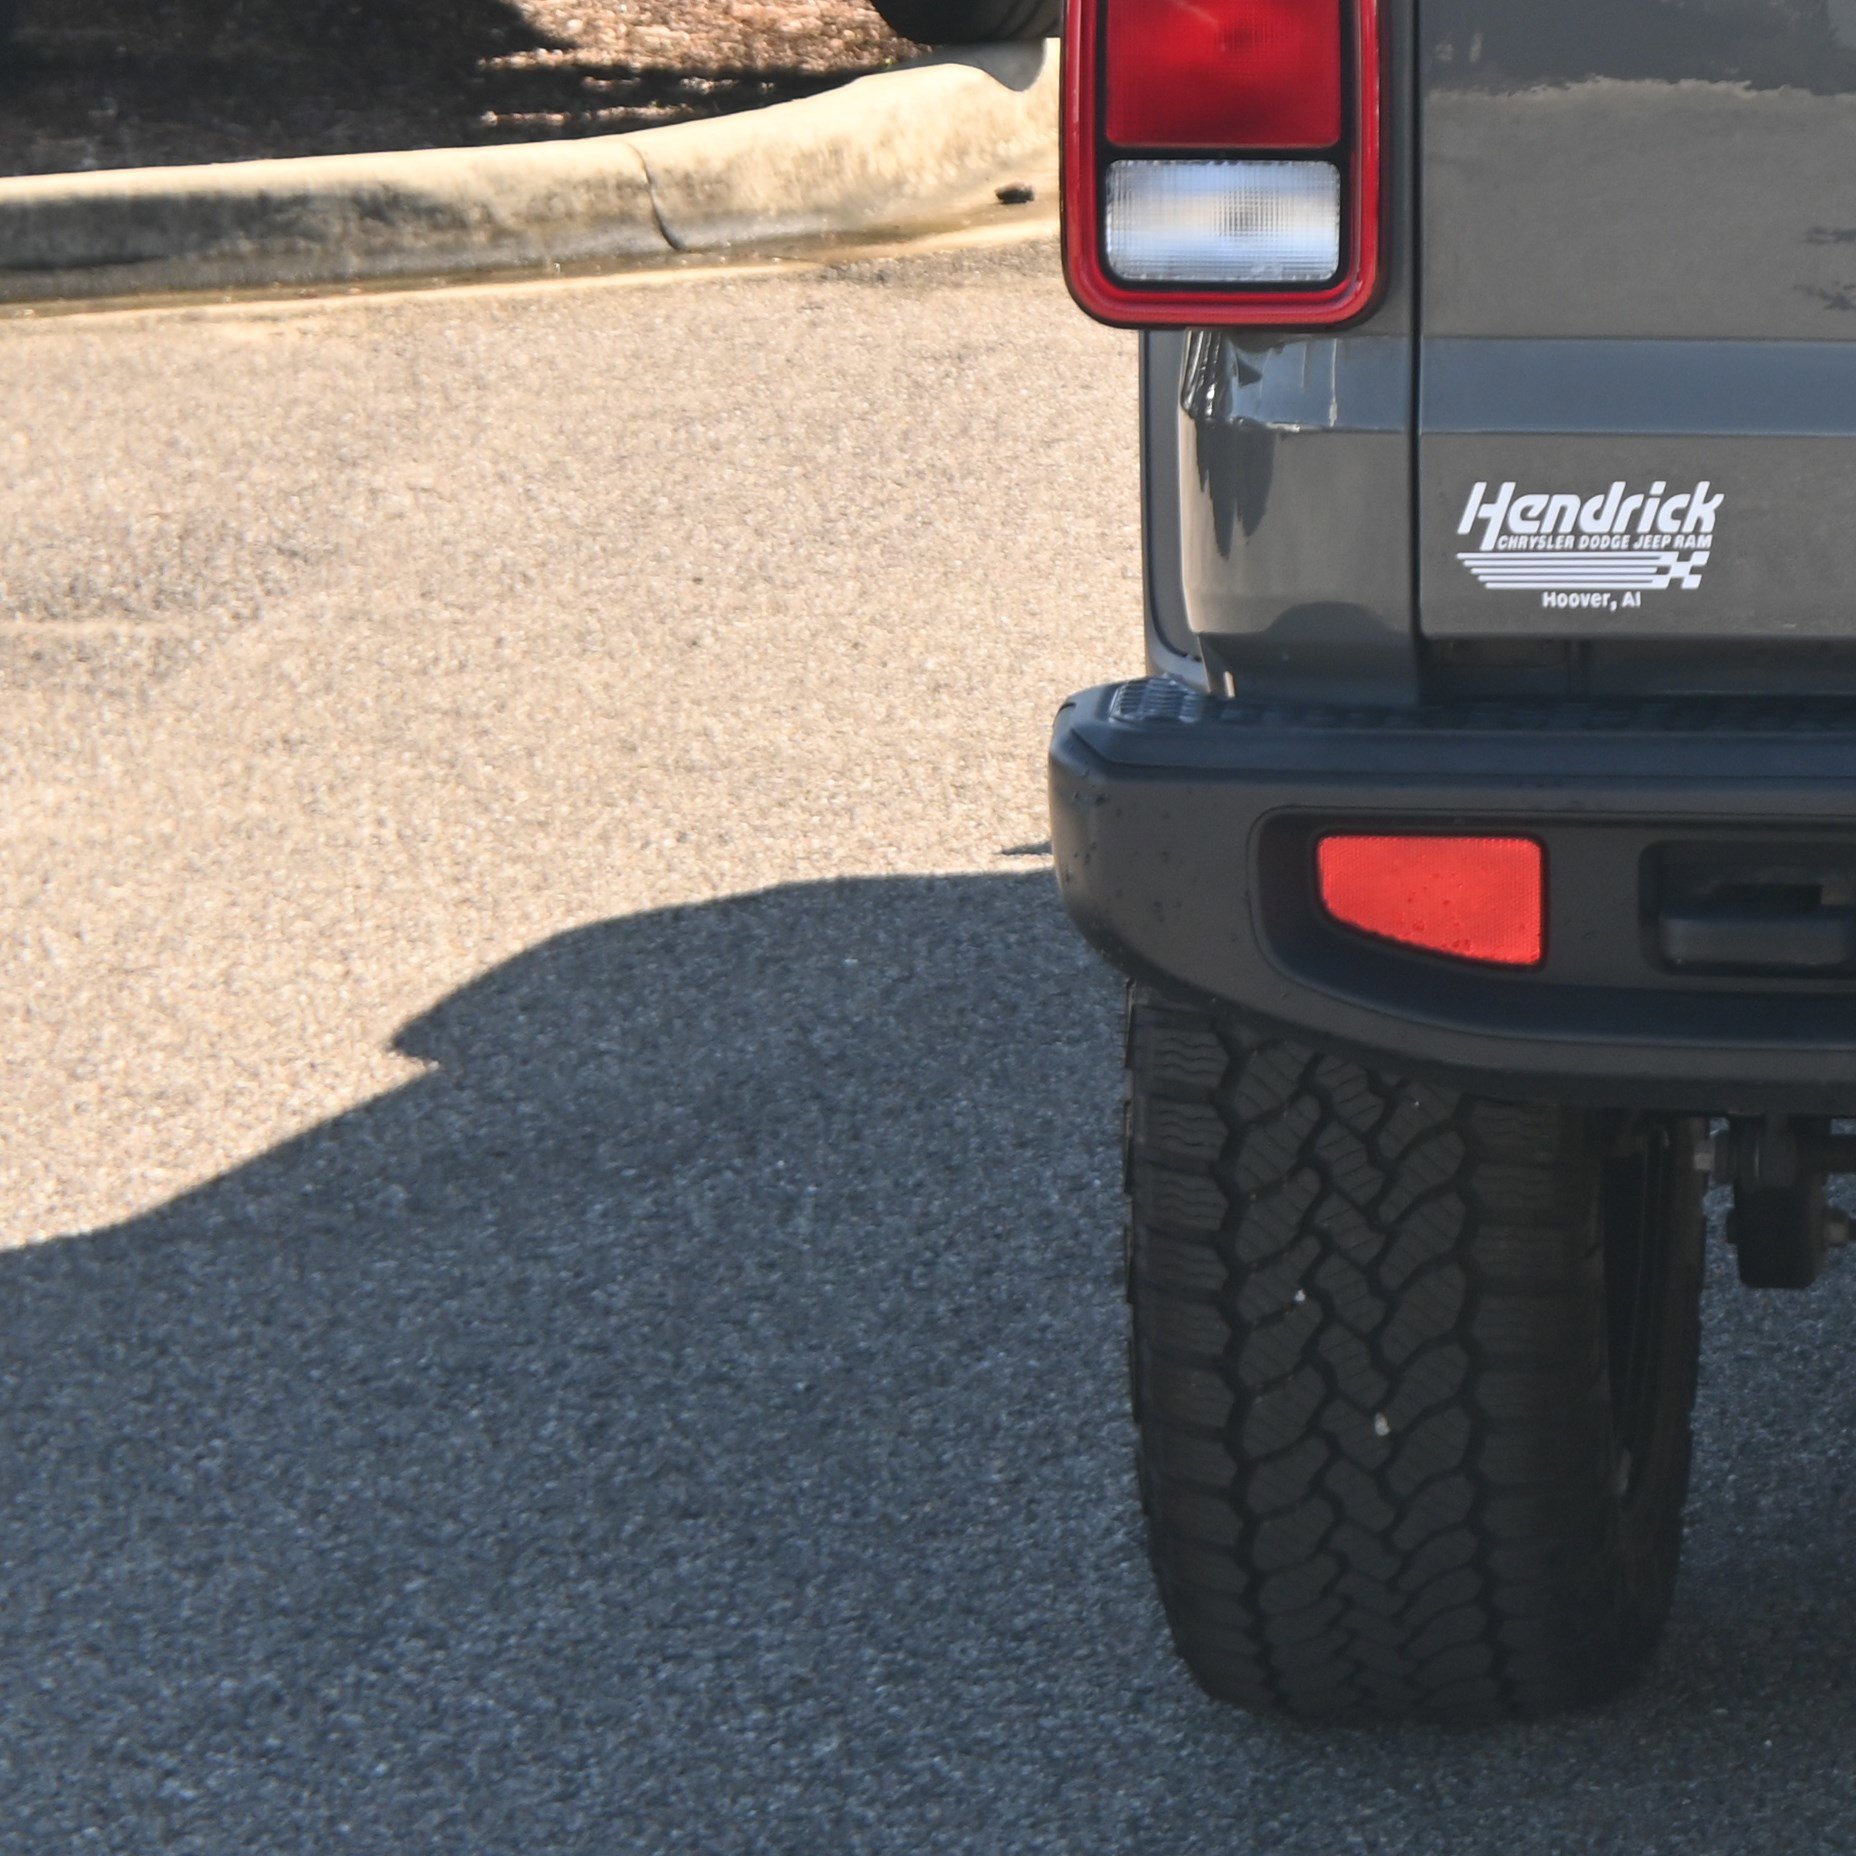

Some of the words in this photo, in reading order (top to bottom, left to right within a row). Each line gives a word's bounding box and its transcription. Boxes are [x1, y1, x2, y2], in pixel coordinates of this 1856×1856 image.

[1456, 480, 1725, 551] Hendrick
[1497, 535, 1575, 550] CHRYSLER
[1578, 534, 1631, 550] DODGE
[1633, 534, 1672, 550] JEEP
[1674, 533, 1714, 549] RAM
[1542, 591, 1618, 612] Hoover,
